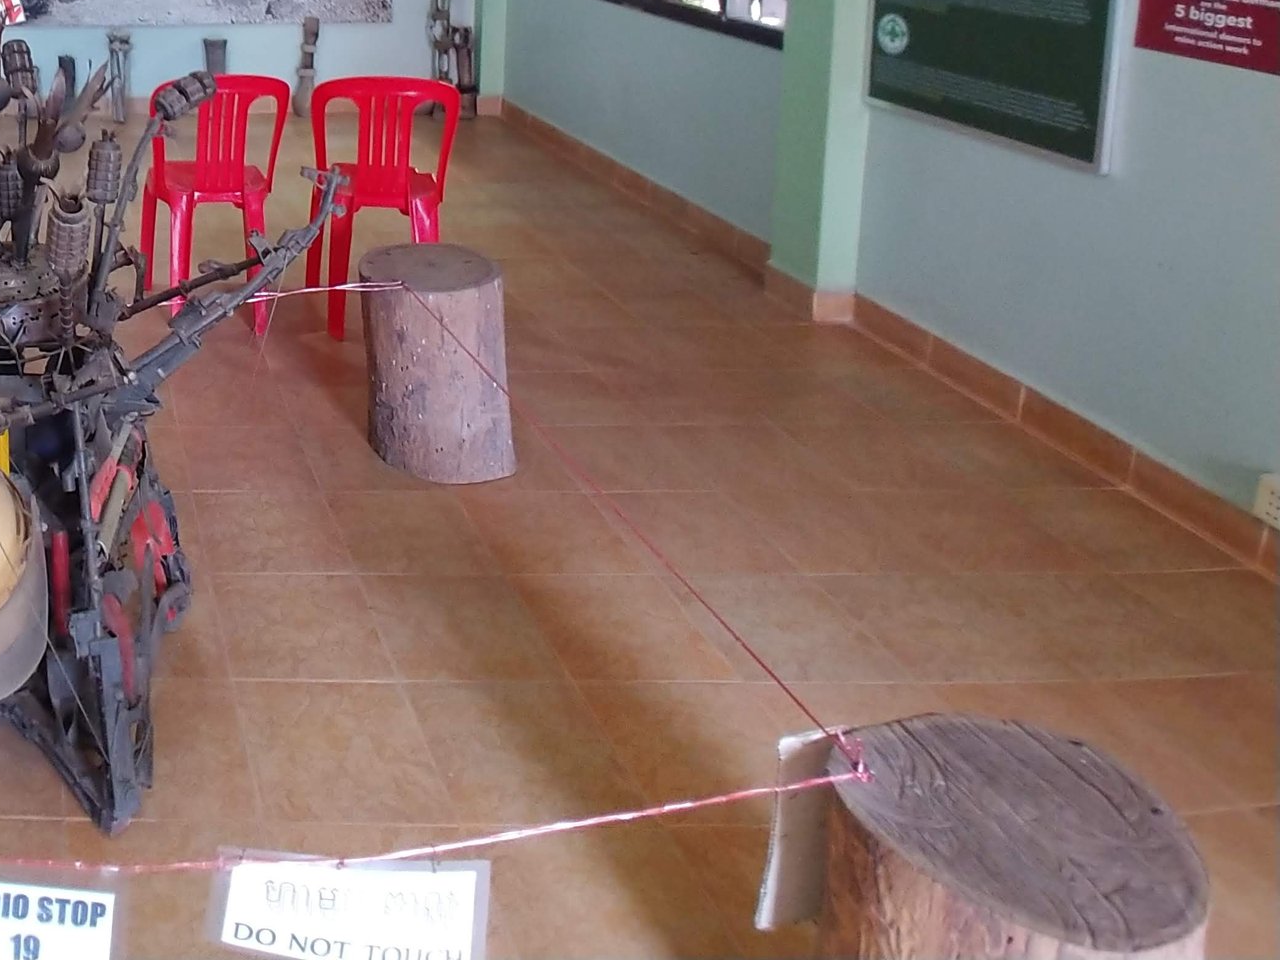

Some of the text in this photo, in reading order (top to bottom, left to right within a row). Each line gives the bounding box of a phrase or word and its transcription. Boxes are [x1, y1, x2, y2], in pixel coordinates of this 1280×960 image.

[1175, 3, 1253, 29] 5 biggest
[37, 896, 106, 928] STOP
[10, 933, 41, 960] 19
[233, 922, 276, 946] DO
[289, 933, 351, 960] NOT
